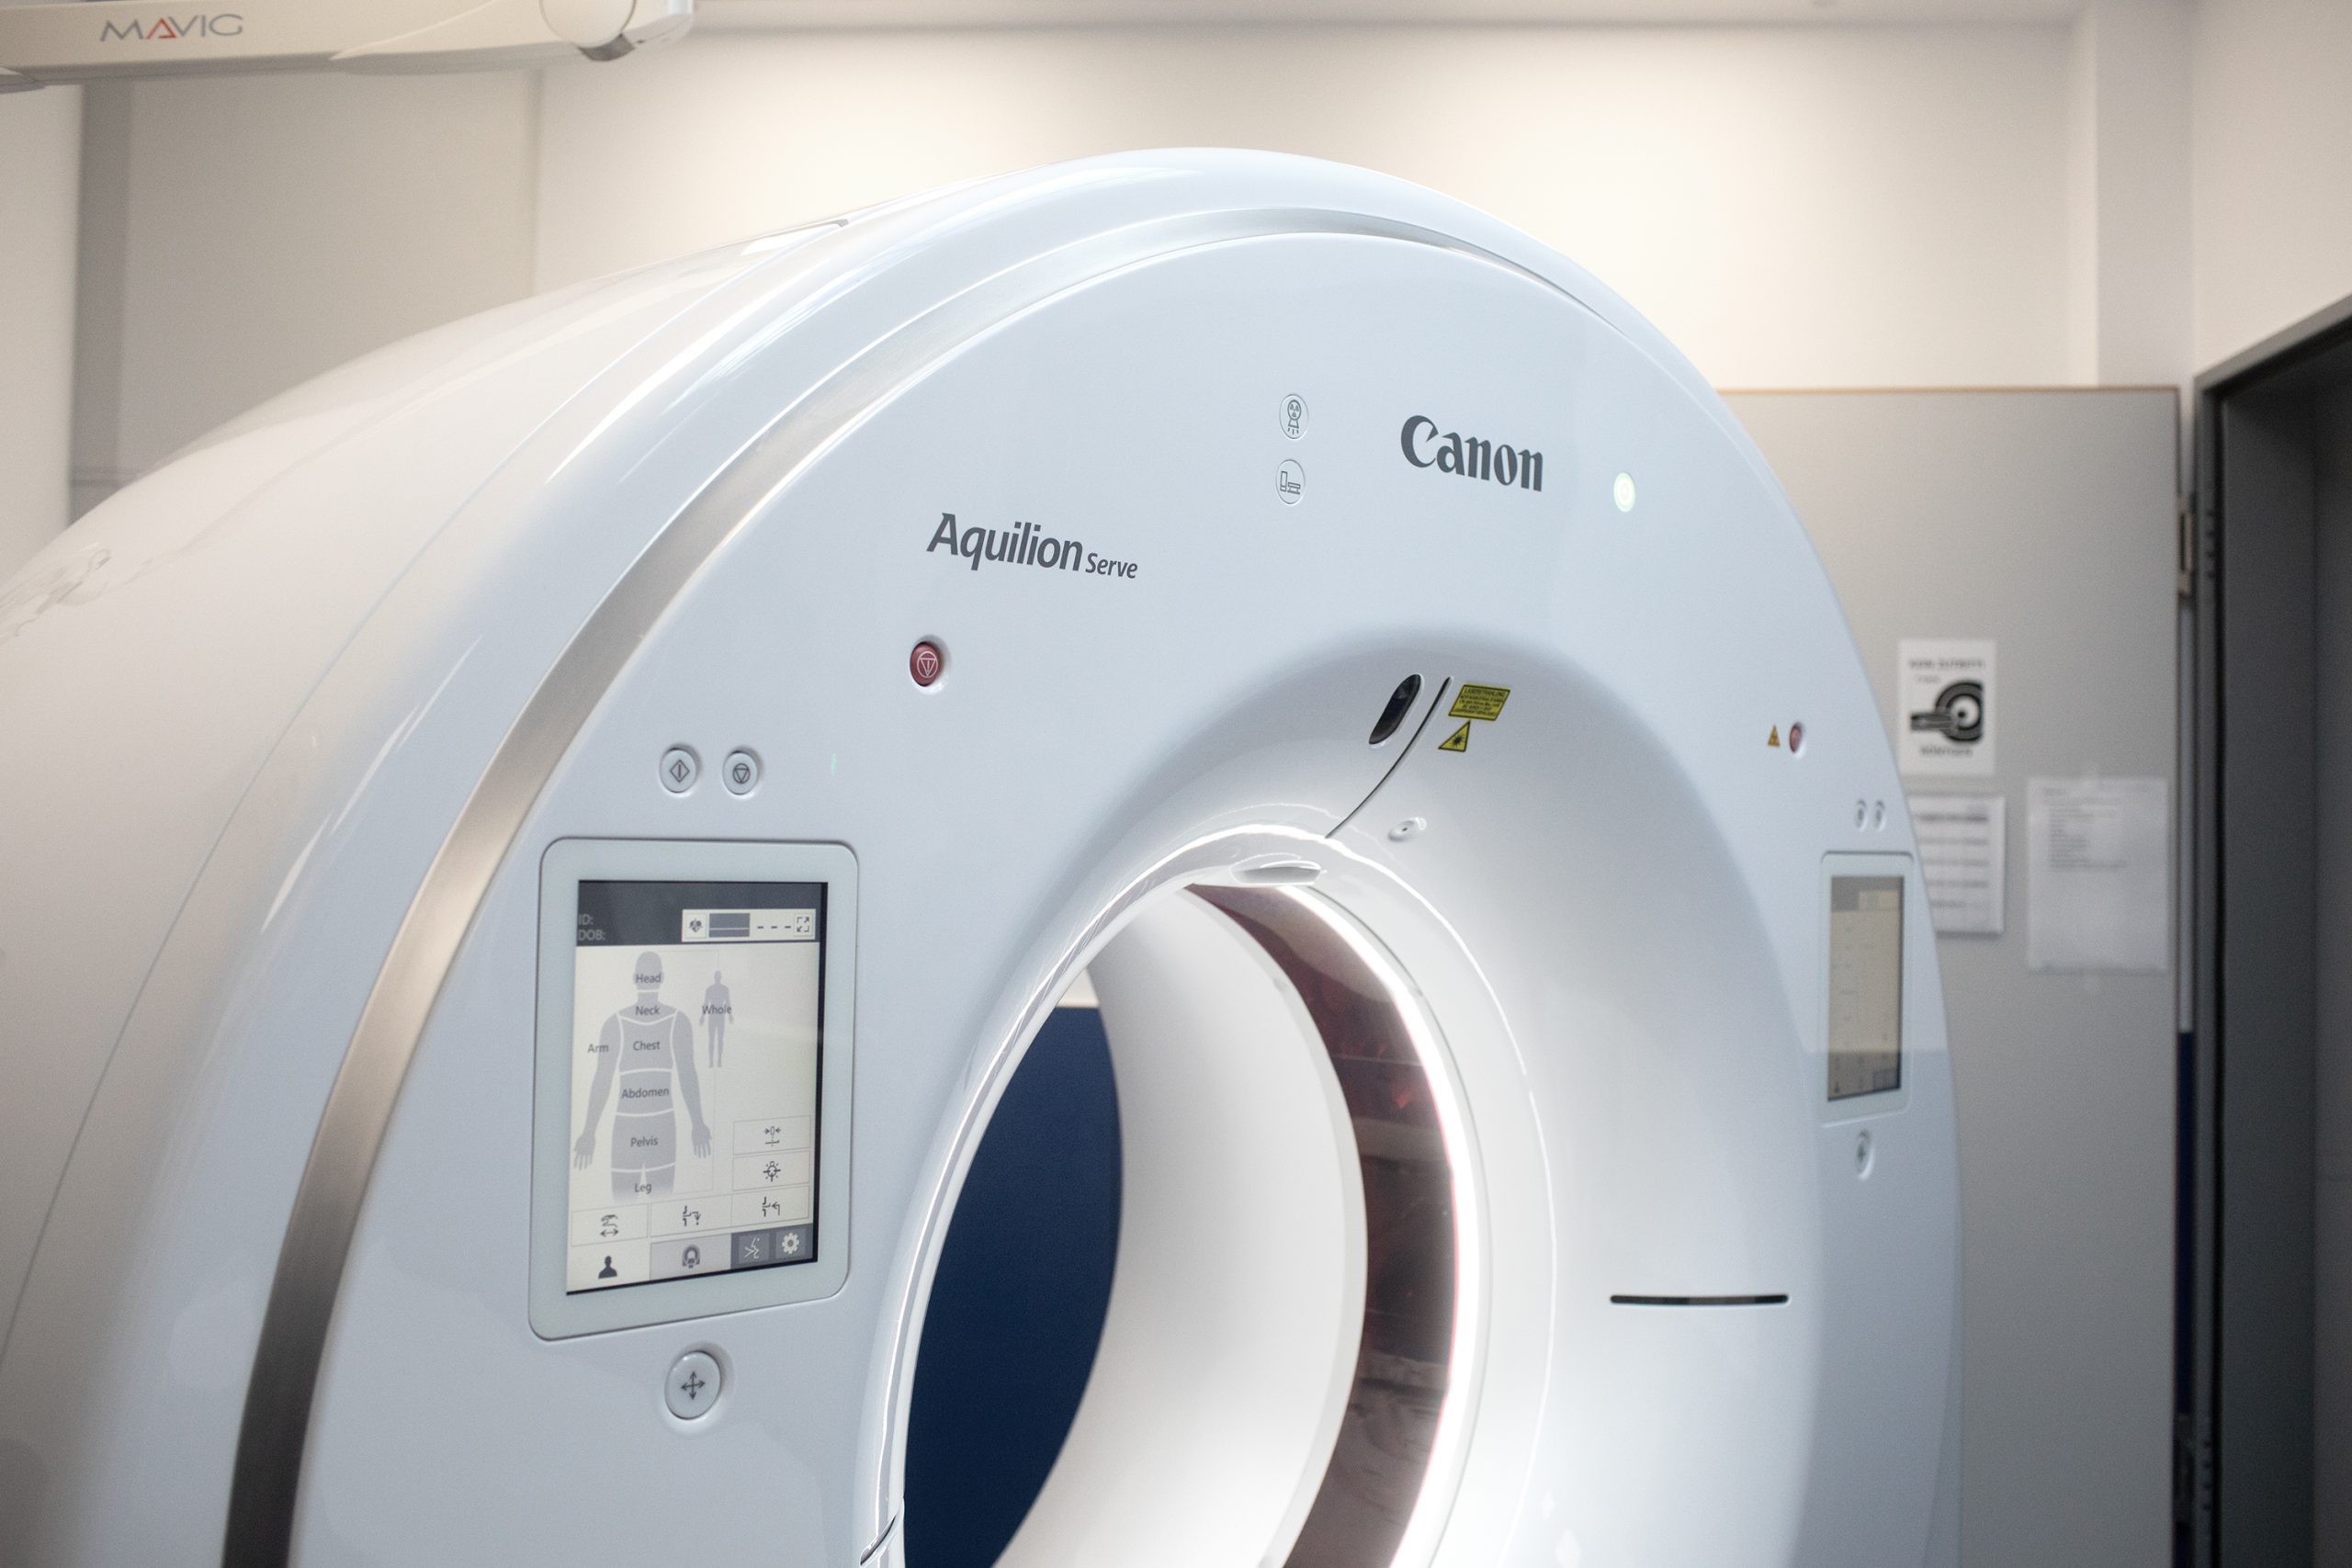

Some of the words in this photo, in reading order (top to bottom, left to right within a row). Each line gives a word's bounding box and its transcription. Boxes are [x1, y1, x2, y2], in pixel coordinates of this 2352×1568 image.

[100, 13, 243, 42] MAVIG
[1400, 414, 1544, 491] Canon
[926, 512, 1083, 571] Aquilion
[1085, 552, 1138, 579] Serve
[635, 973, 662, 983] Head
[635, 1005, 660, 1016] Neck
[701, 1004, 732, 1015] Whole
[587, 1043, 609, 1054] Arm
[632, 1040, 661, 1051] Chest
[621, 1087, 670, 1100] Abdomen
[630, 1135, 659, 1147] Pelvis
[634, 1181, 652, 1194] Leg
